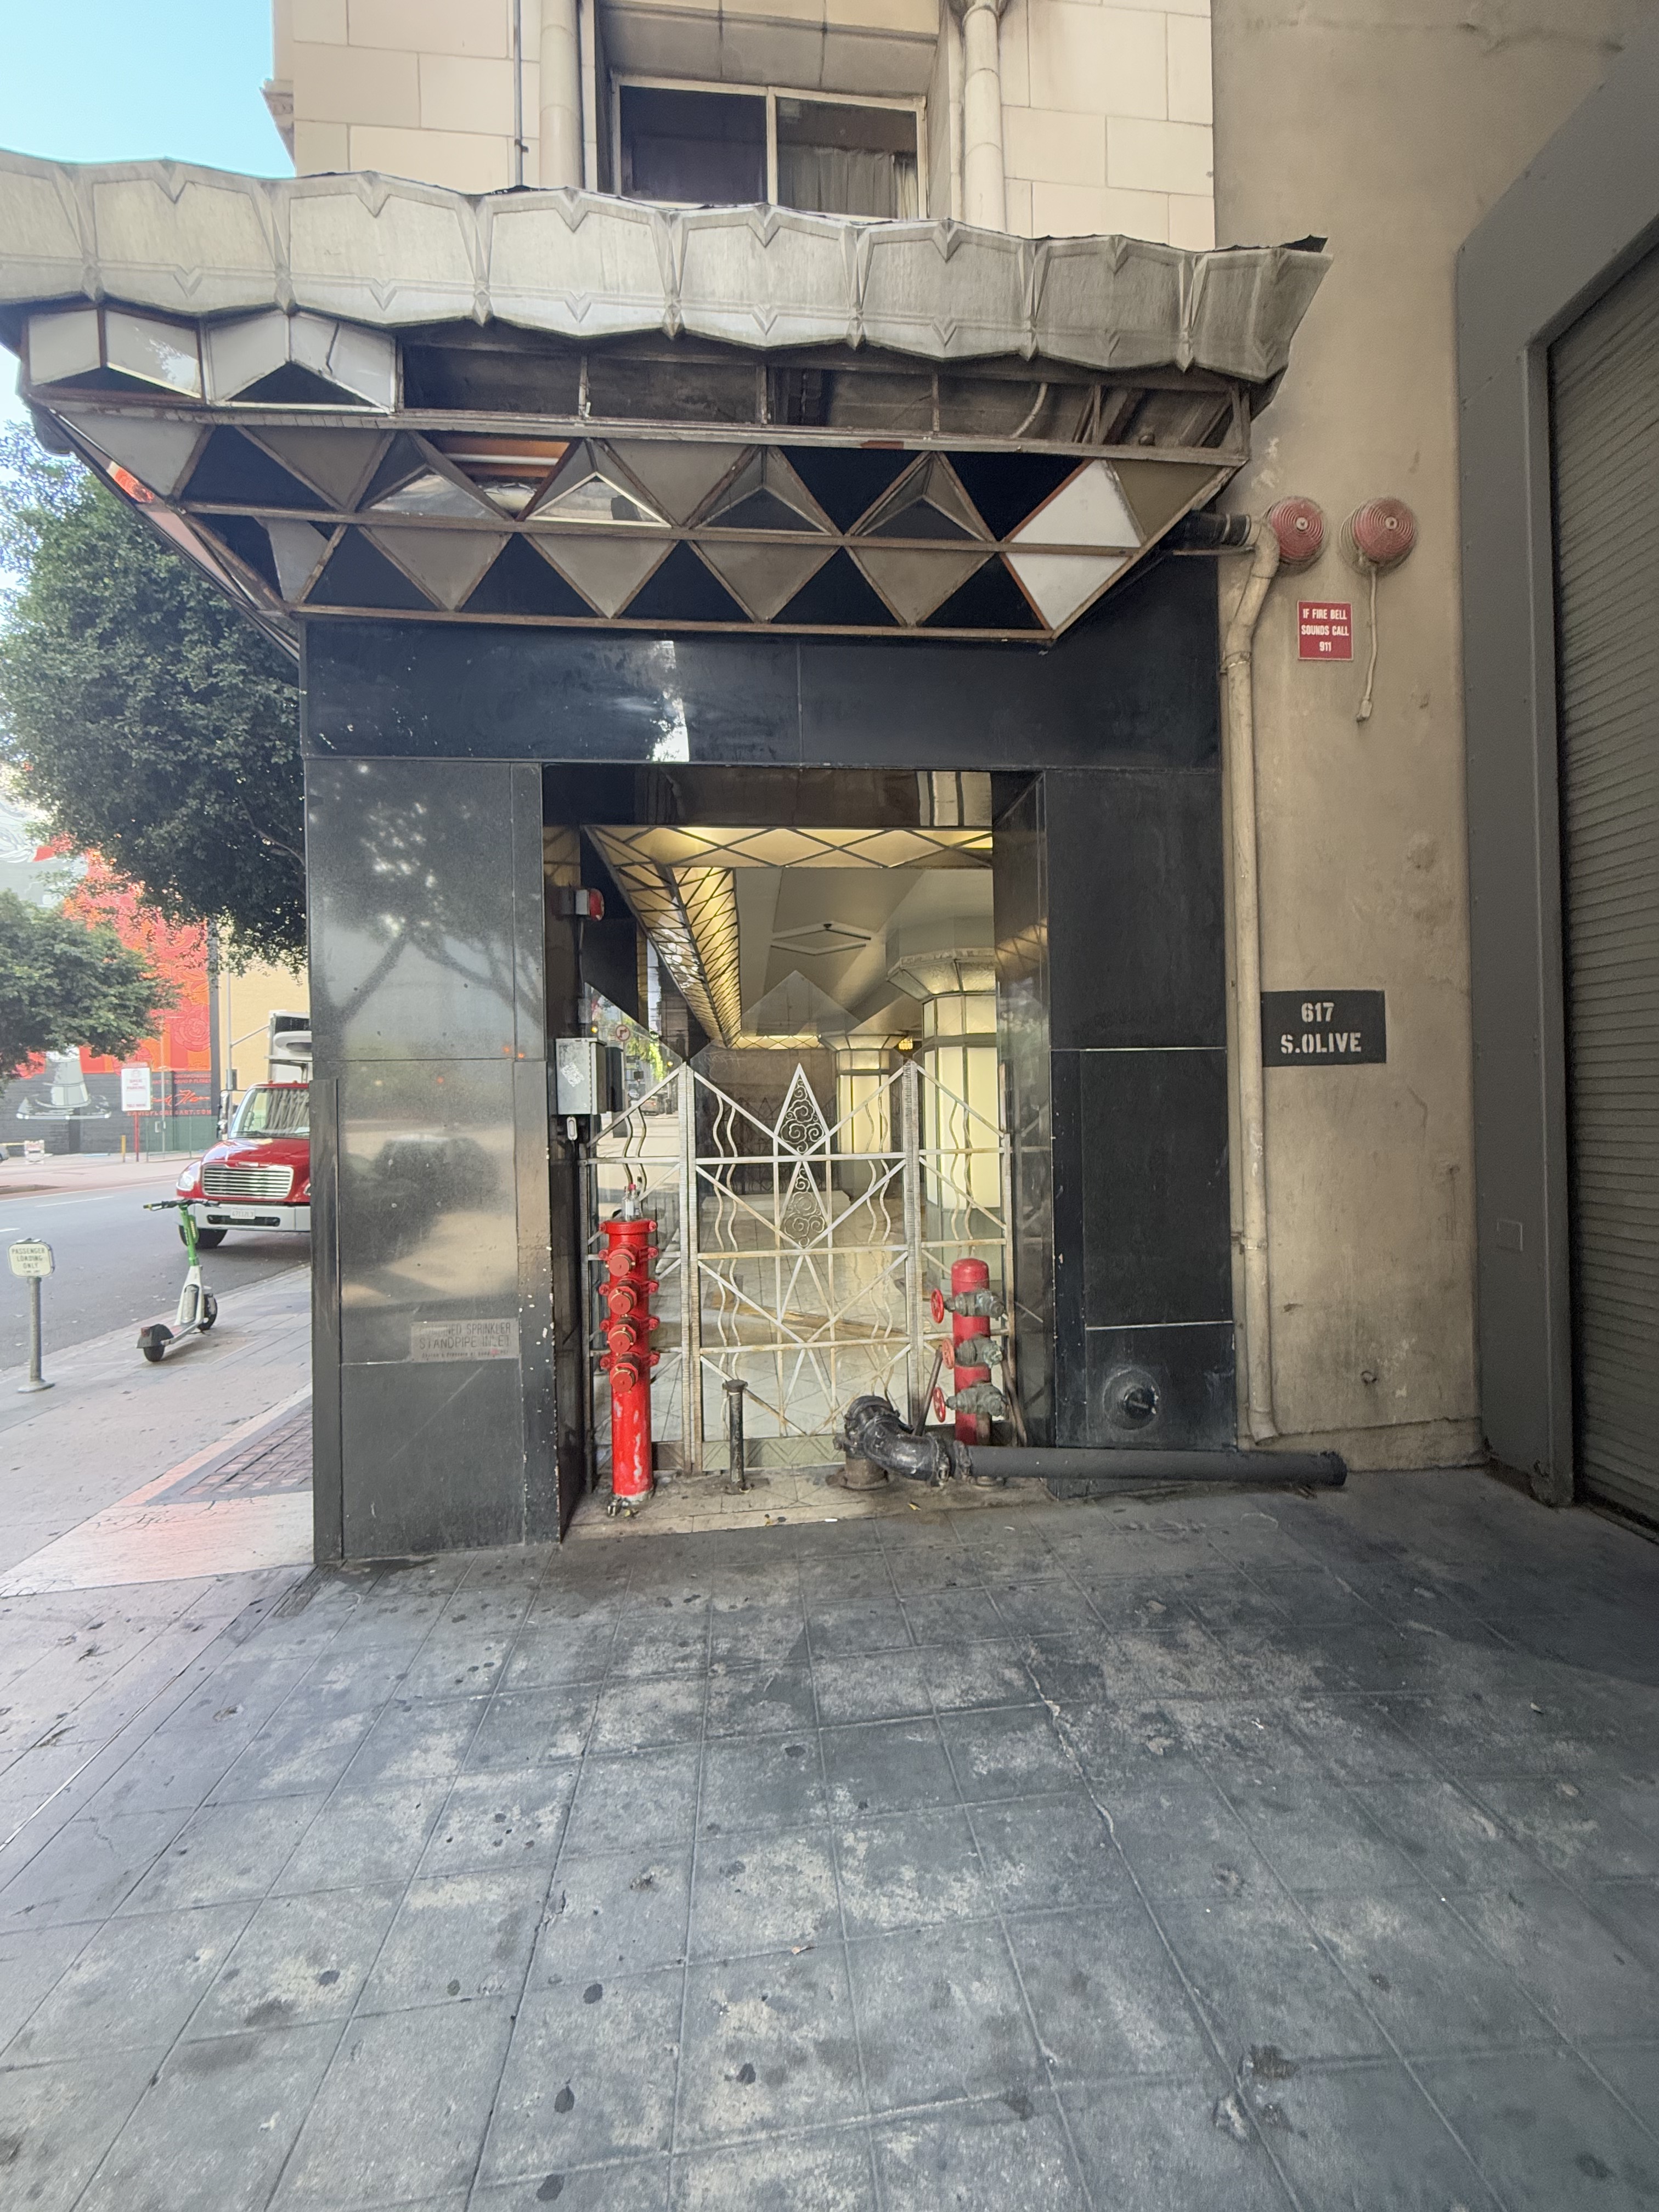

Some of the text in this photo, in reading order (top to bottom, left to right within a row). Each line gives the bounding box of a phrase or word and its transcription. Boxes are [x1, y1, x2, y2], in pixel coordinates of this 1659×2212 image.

[1302, 608, 1347, 620] IF FIRE BELL
[1301, 625, 1350, 636] SOUNDS CALL
[1319, 641, 1332, 652] 911
[1301, 1002, 1335, 1023] 617
[1280, 1032, 1362, 1054] S.OLIVE
[467, 1322, 511, 1335] SPRINKLER
[419, 1335, 477, 1350] STANDPIPE
